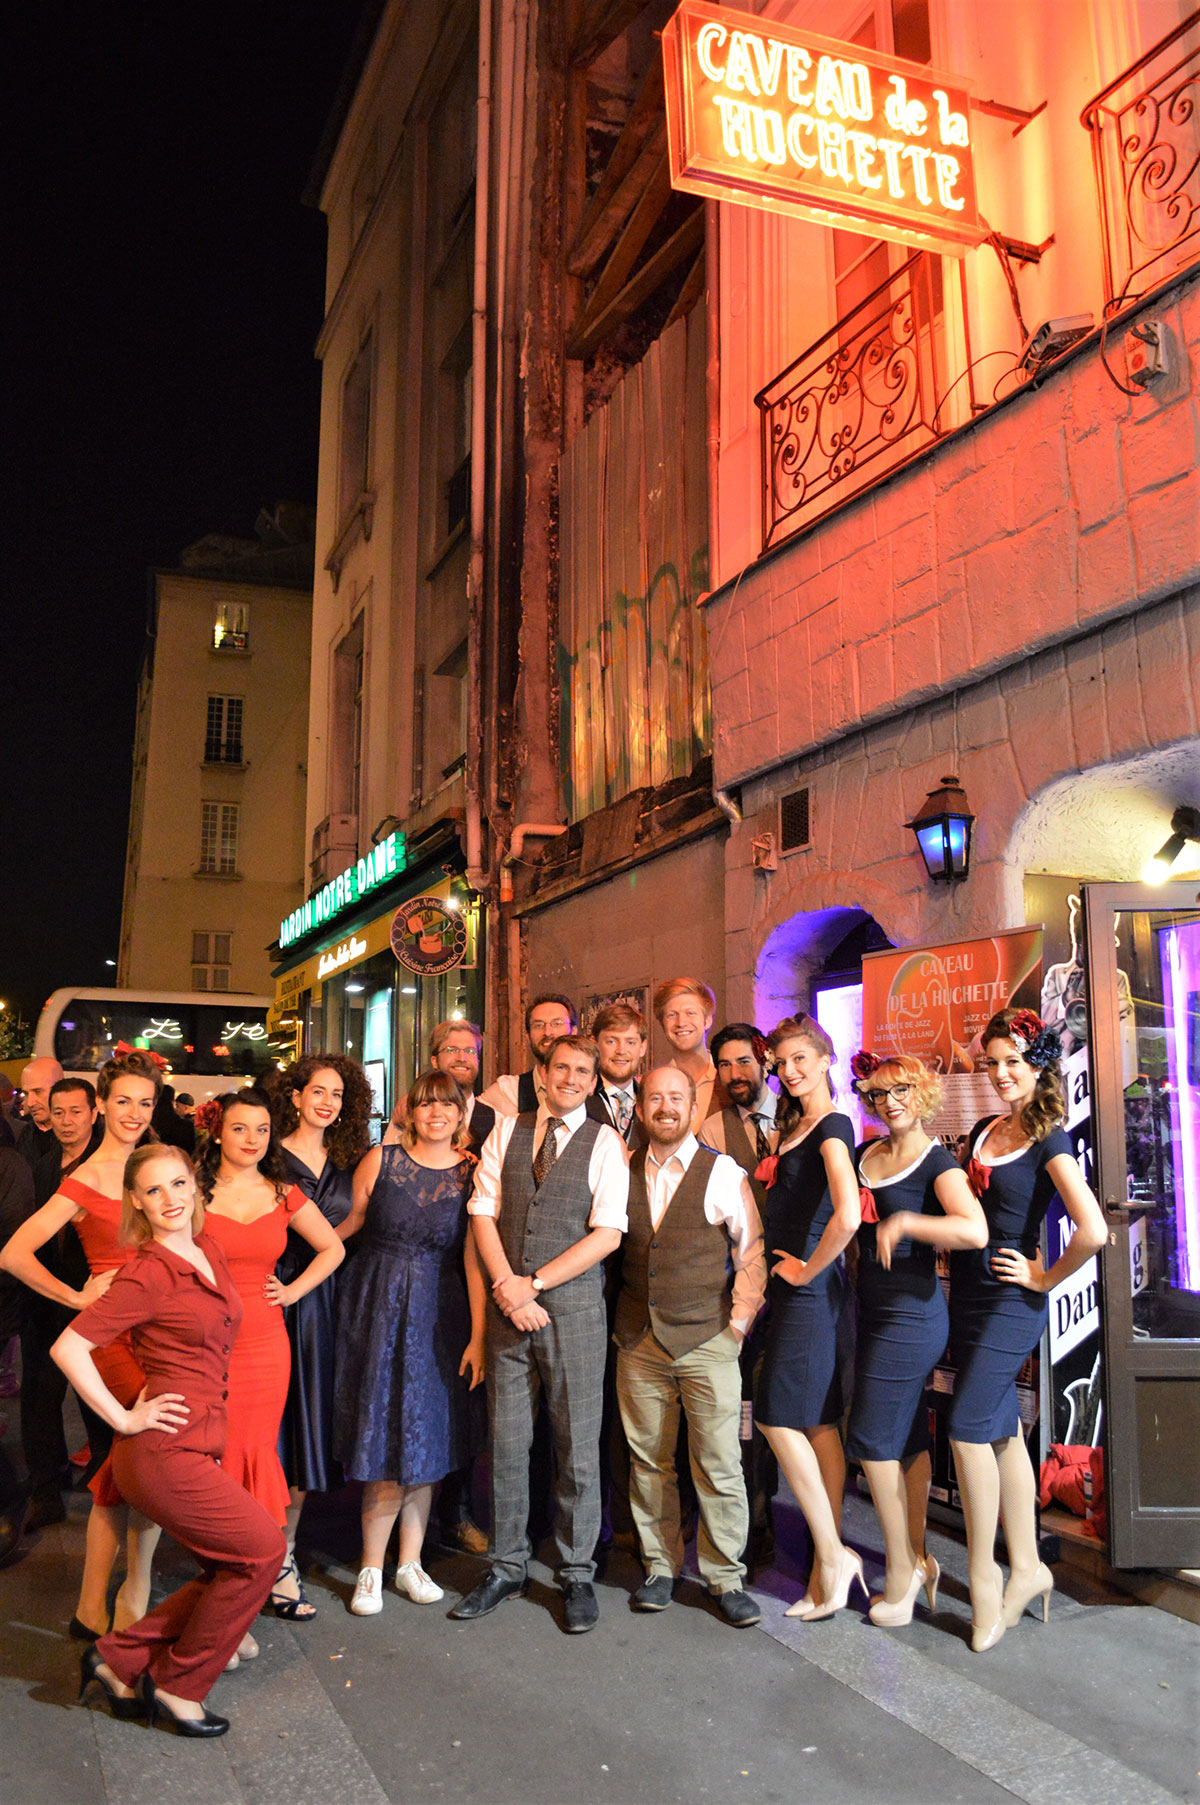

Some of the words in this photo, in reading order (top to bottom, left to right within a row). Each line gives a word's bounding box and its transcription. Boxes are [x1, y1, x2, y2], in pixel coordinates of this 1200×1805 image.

[697, 22, 873, 121] CAVEAU
[885, 75, 927, 136] de
[933, 89, 969, 147] la
[712, 95, 965, 211] HUCHETTE
[279, 899, 313, 949] JARDIN
[315, 867, 353, 922] NOTRE
[357, 832, 402, 894] DAME
[400, 951, 424, 972] Cuisine
[920, 953, 974, 977] CAVEAU
[890, 993, 907, 1012] DE
[912, 991, 928, 1009] LA
[932, 981, 1009, 1007] HUCHETTE
[915, 1019, 931, 1028] JAZZ
[963, 1013, 980, 1023] JAZZ
[963, 1024, 986, 1034] MOVIE
[917, 1030, 935, 1038] LAND
